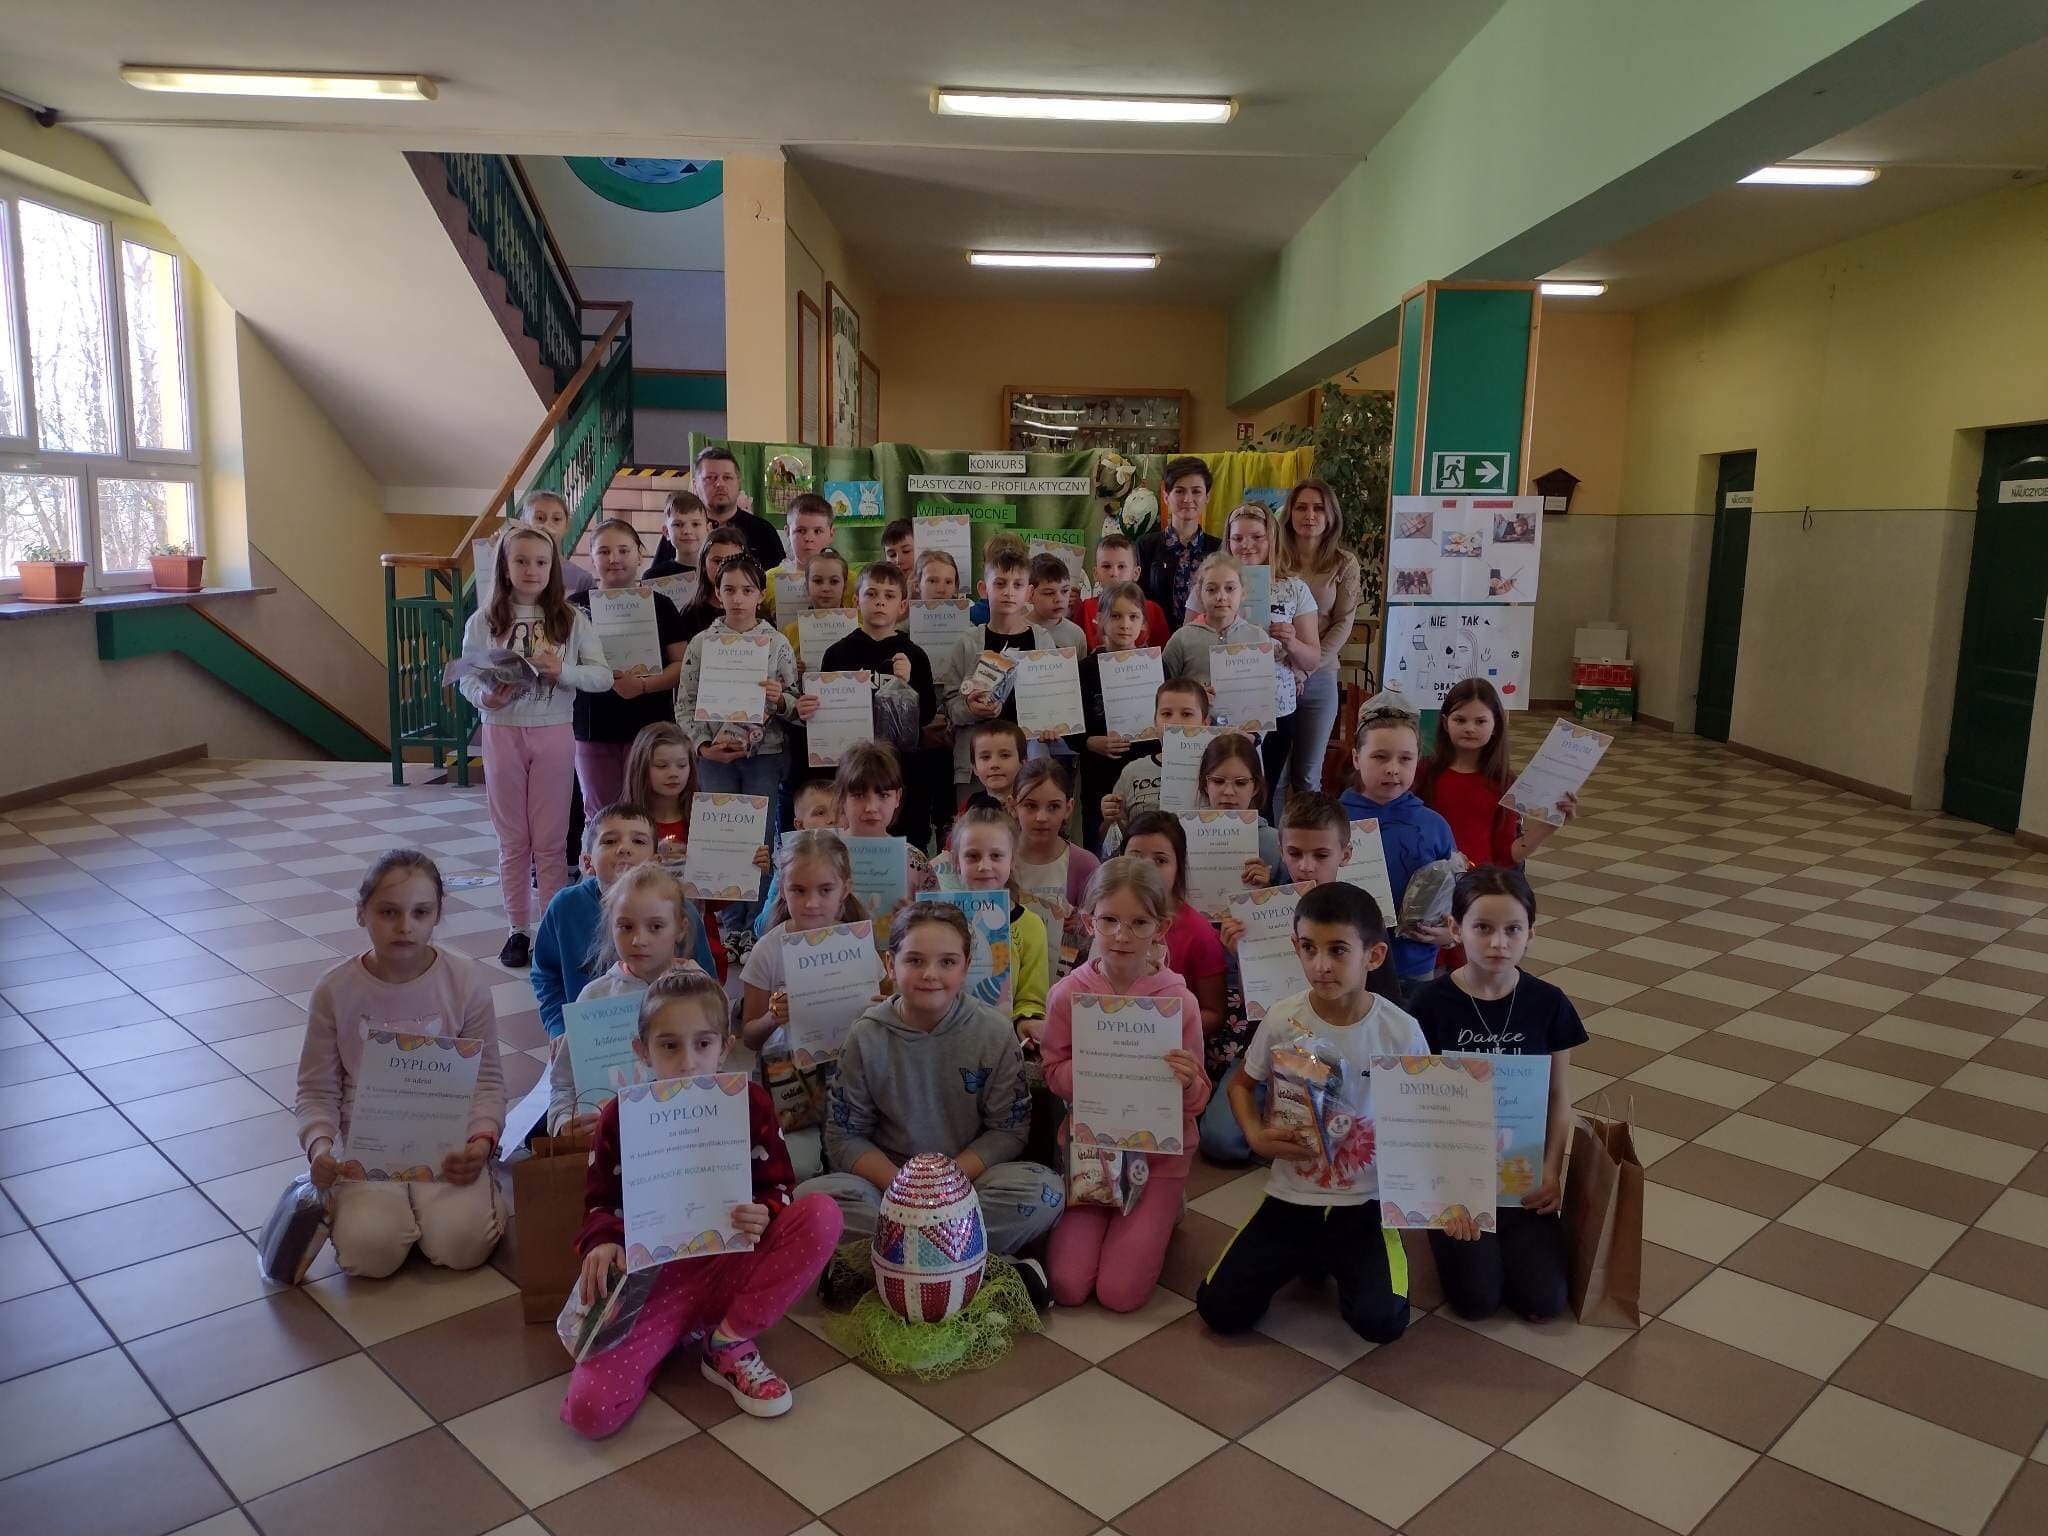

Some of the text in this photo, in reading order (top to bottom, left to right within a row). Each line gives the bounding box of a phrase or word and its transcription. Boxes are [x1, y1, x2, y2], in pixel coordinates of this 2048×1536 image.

[970, 459, 1025, 470] KONKURS
[909, 478, 982, 491] PLASTYCZNO
[991, 480, 1087, 492] PROFILAKTYCZNY
[1430, 615, 1480, 627] NIE TAK
[820, 686, 856, 695] DYPLOM
[702, 811, 756, 825] DYPLOM
[1197, 828, 1240, 837] DYPLOM
[798, 947, 863, 970] DYPLOM
[1097, 1020, 1157, 1034] DYPLOM
[1457, 1029, 1525, 1046] Dance
[389, 1056, 453, 1073] DYPLOM
[649, 1103, 719, 1126] DYPLOM
